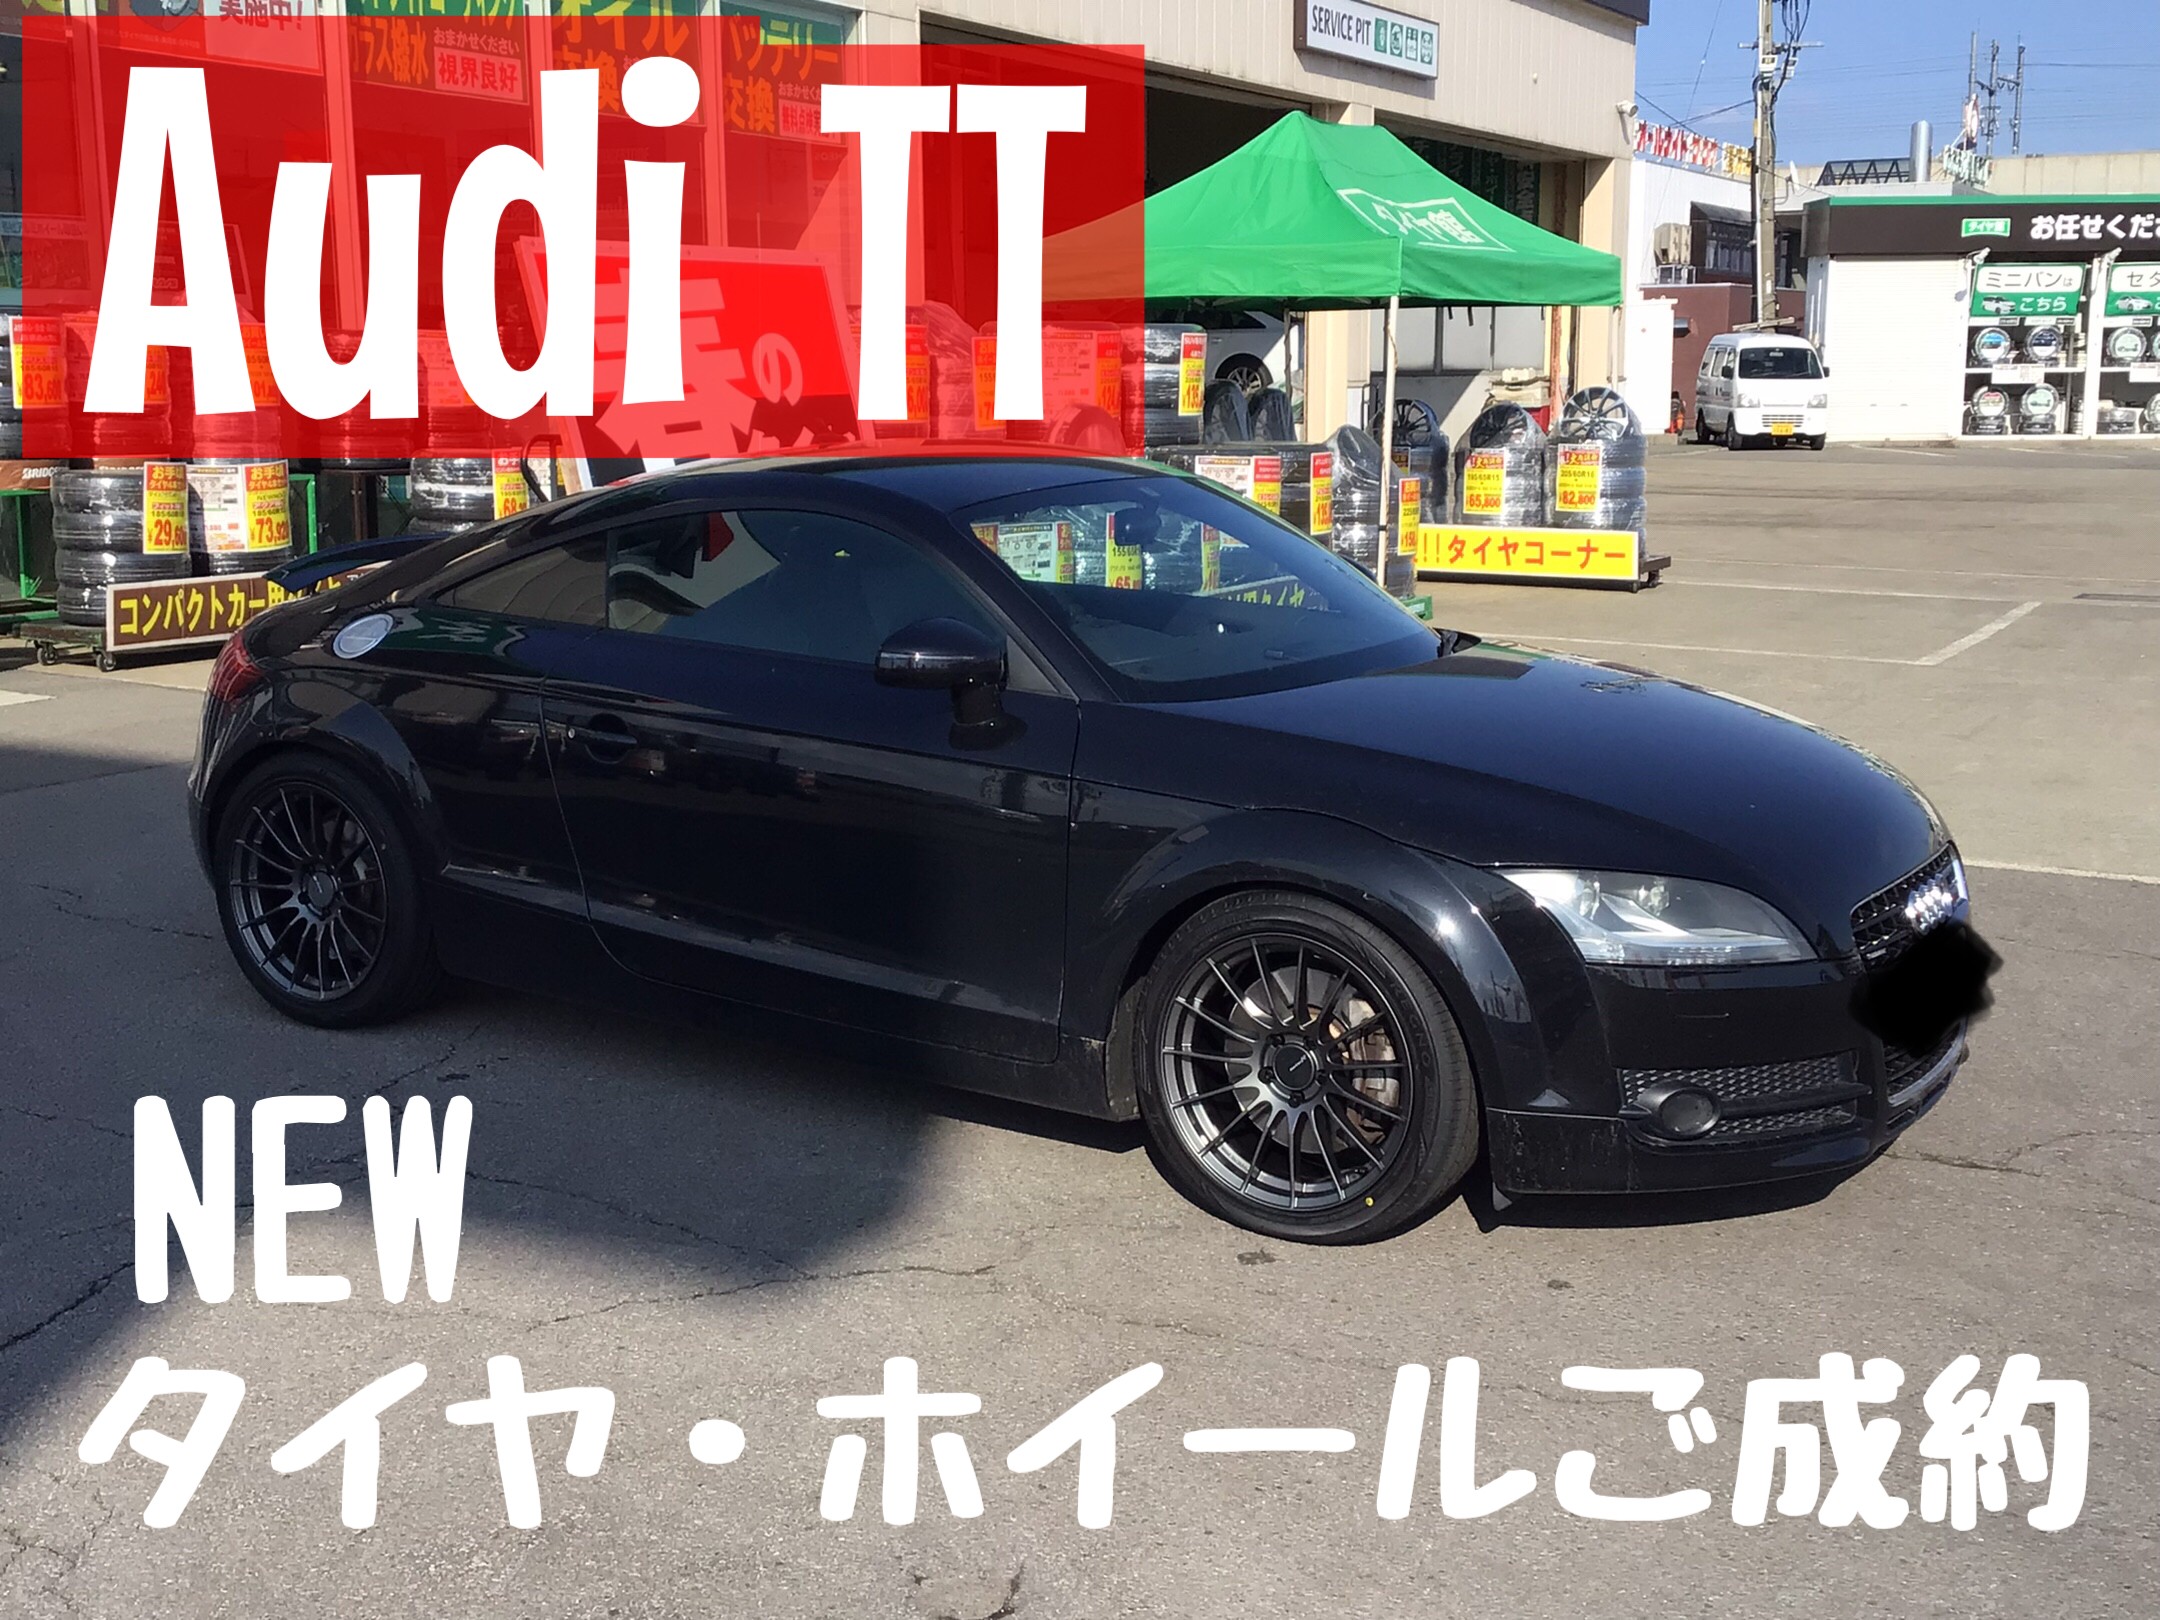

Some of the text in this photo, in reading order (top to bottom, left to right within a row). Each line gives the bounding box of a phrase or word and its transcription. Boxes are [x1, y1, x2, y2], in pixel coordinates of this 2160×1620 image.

[1312, 4, 1372, 46] SERVICE PIT
[437, 54, 519, 92] 視界良好
[2018, 296, 2068, 312] こちら
[1412, 532, 1626, 570] !!タイヤコーナー
[119, 575, 341, 636] コンパクトカー用
[1389, 981, 1432, 1068] REGNO
